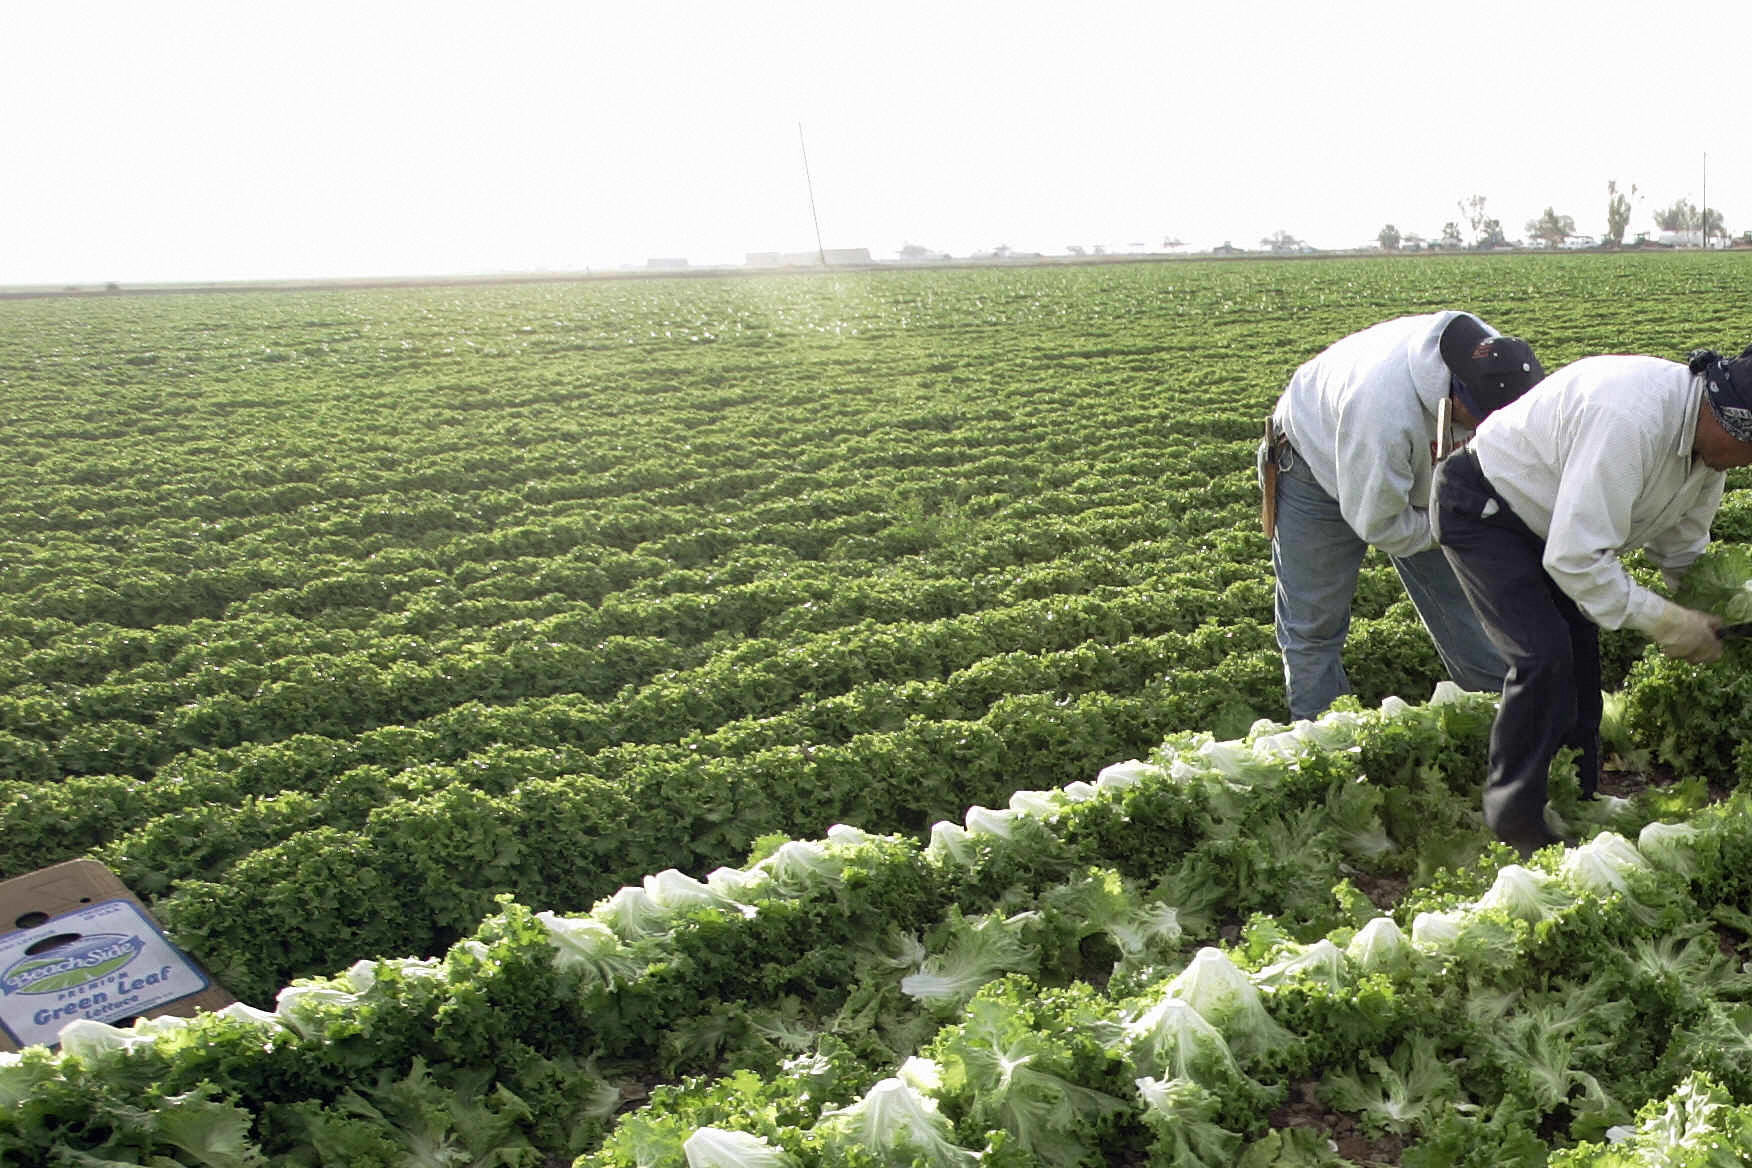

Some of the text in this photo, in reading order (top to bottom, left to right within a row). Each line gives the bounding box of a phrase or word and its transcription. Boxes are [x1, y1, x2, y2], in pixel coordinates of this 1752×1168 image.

[34, 991, 108, 1026] Green
[118, 965, 172, 995] Leaf
[58, 971, 129, 1001] PREMIUM
[85, 994, 140, 1019] Lettuce
